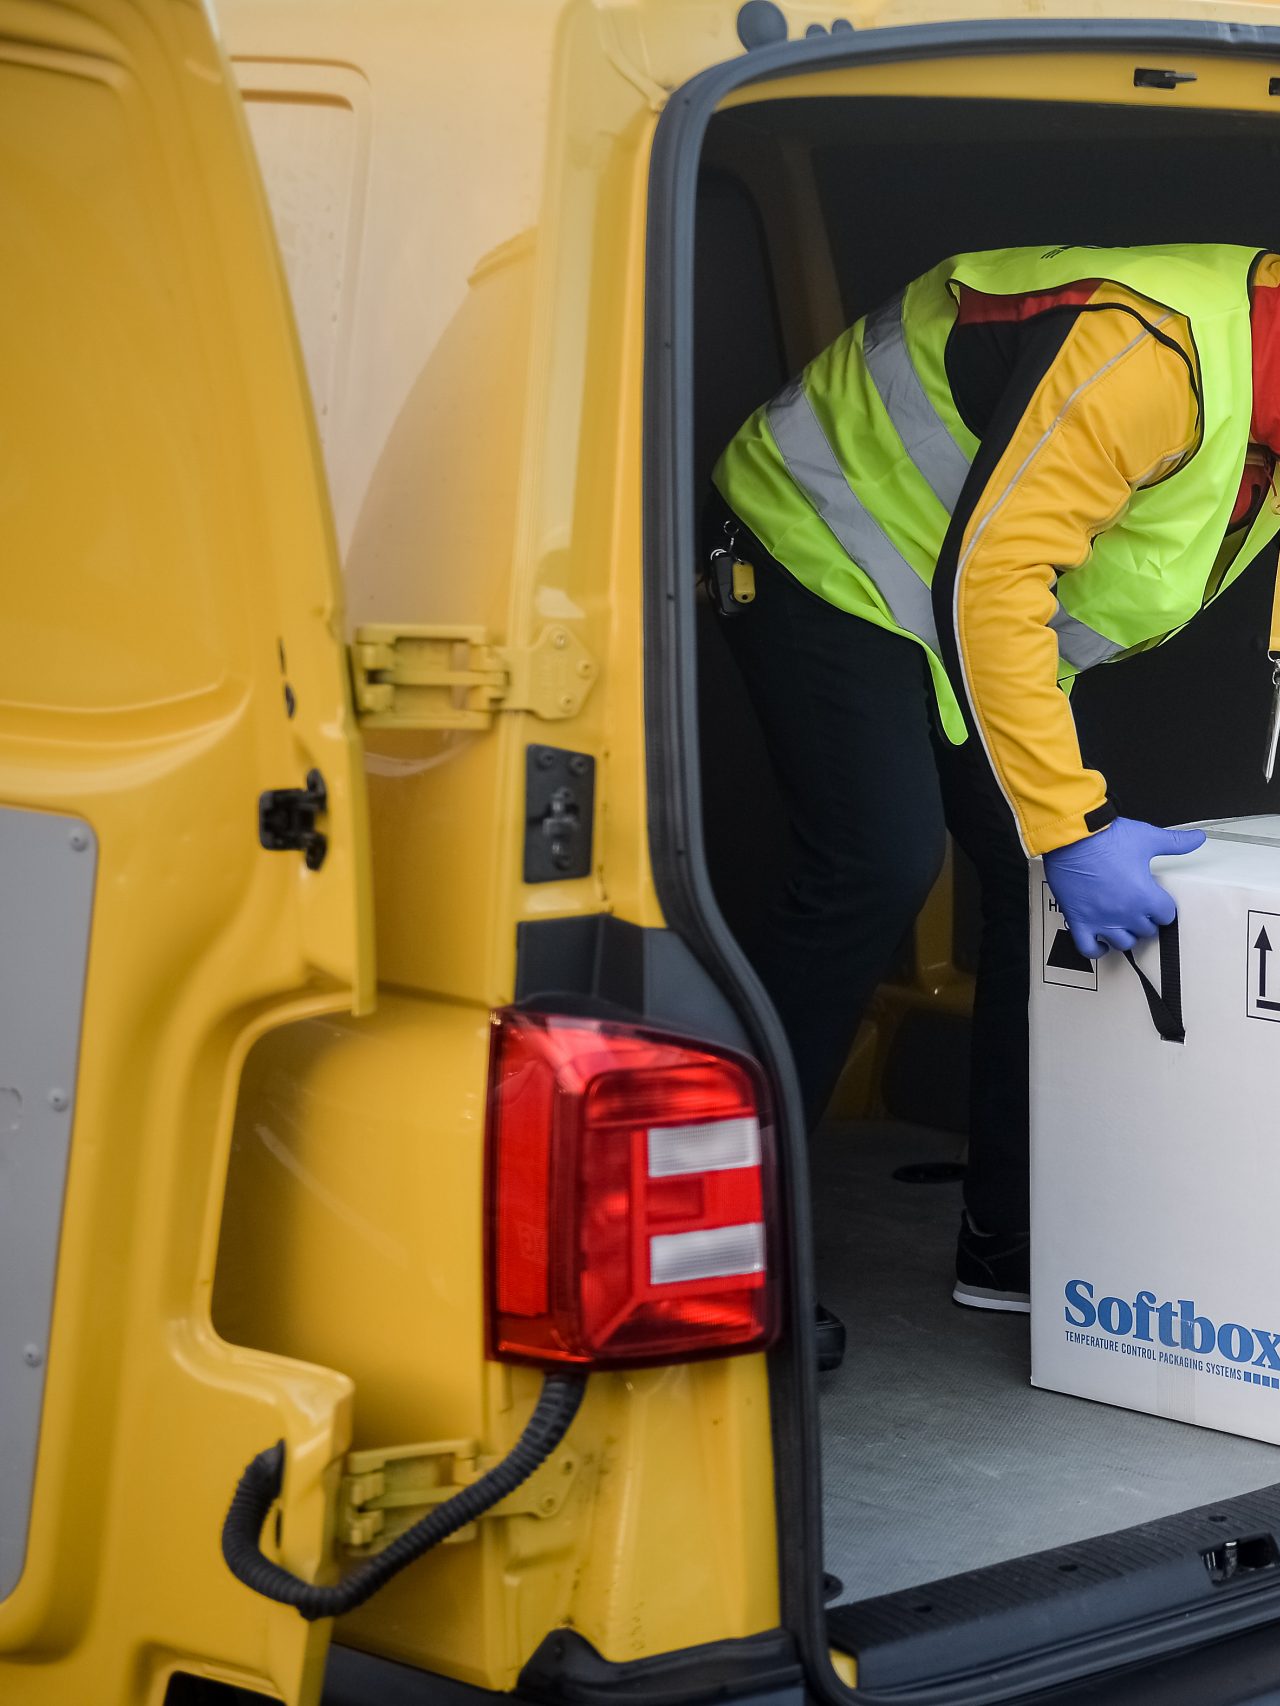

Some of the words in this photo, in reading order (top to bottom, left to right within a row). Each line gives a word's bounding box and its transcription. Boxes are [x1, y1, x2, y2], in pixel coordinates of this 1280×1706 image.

[1065, 1330, 1119, 1352] TEMPERATURE
[1121, 1343, 1157, 1361] CONTROL
[1159, 1351, 1203, 1372] PACKAGING
[1205, 1362, 1242, 1381] SYSTEMS
